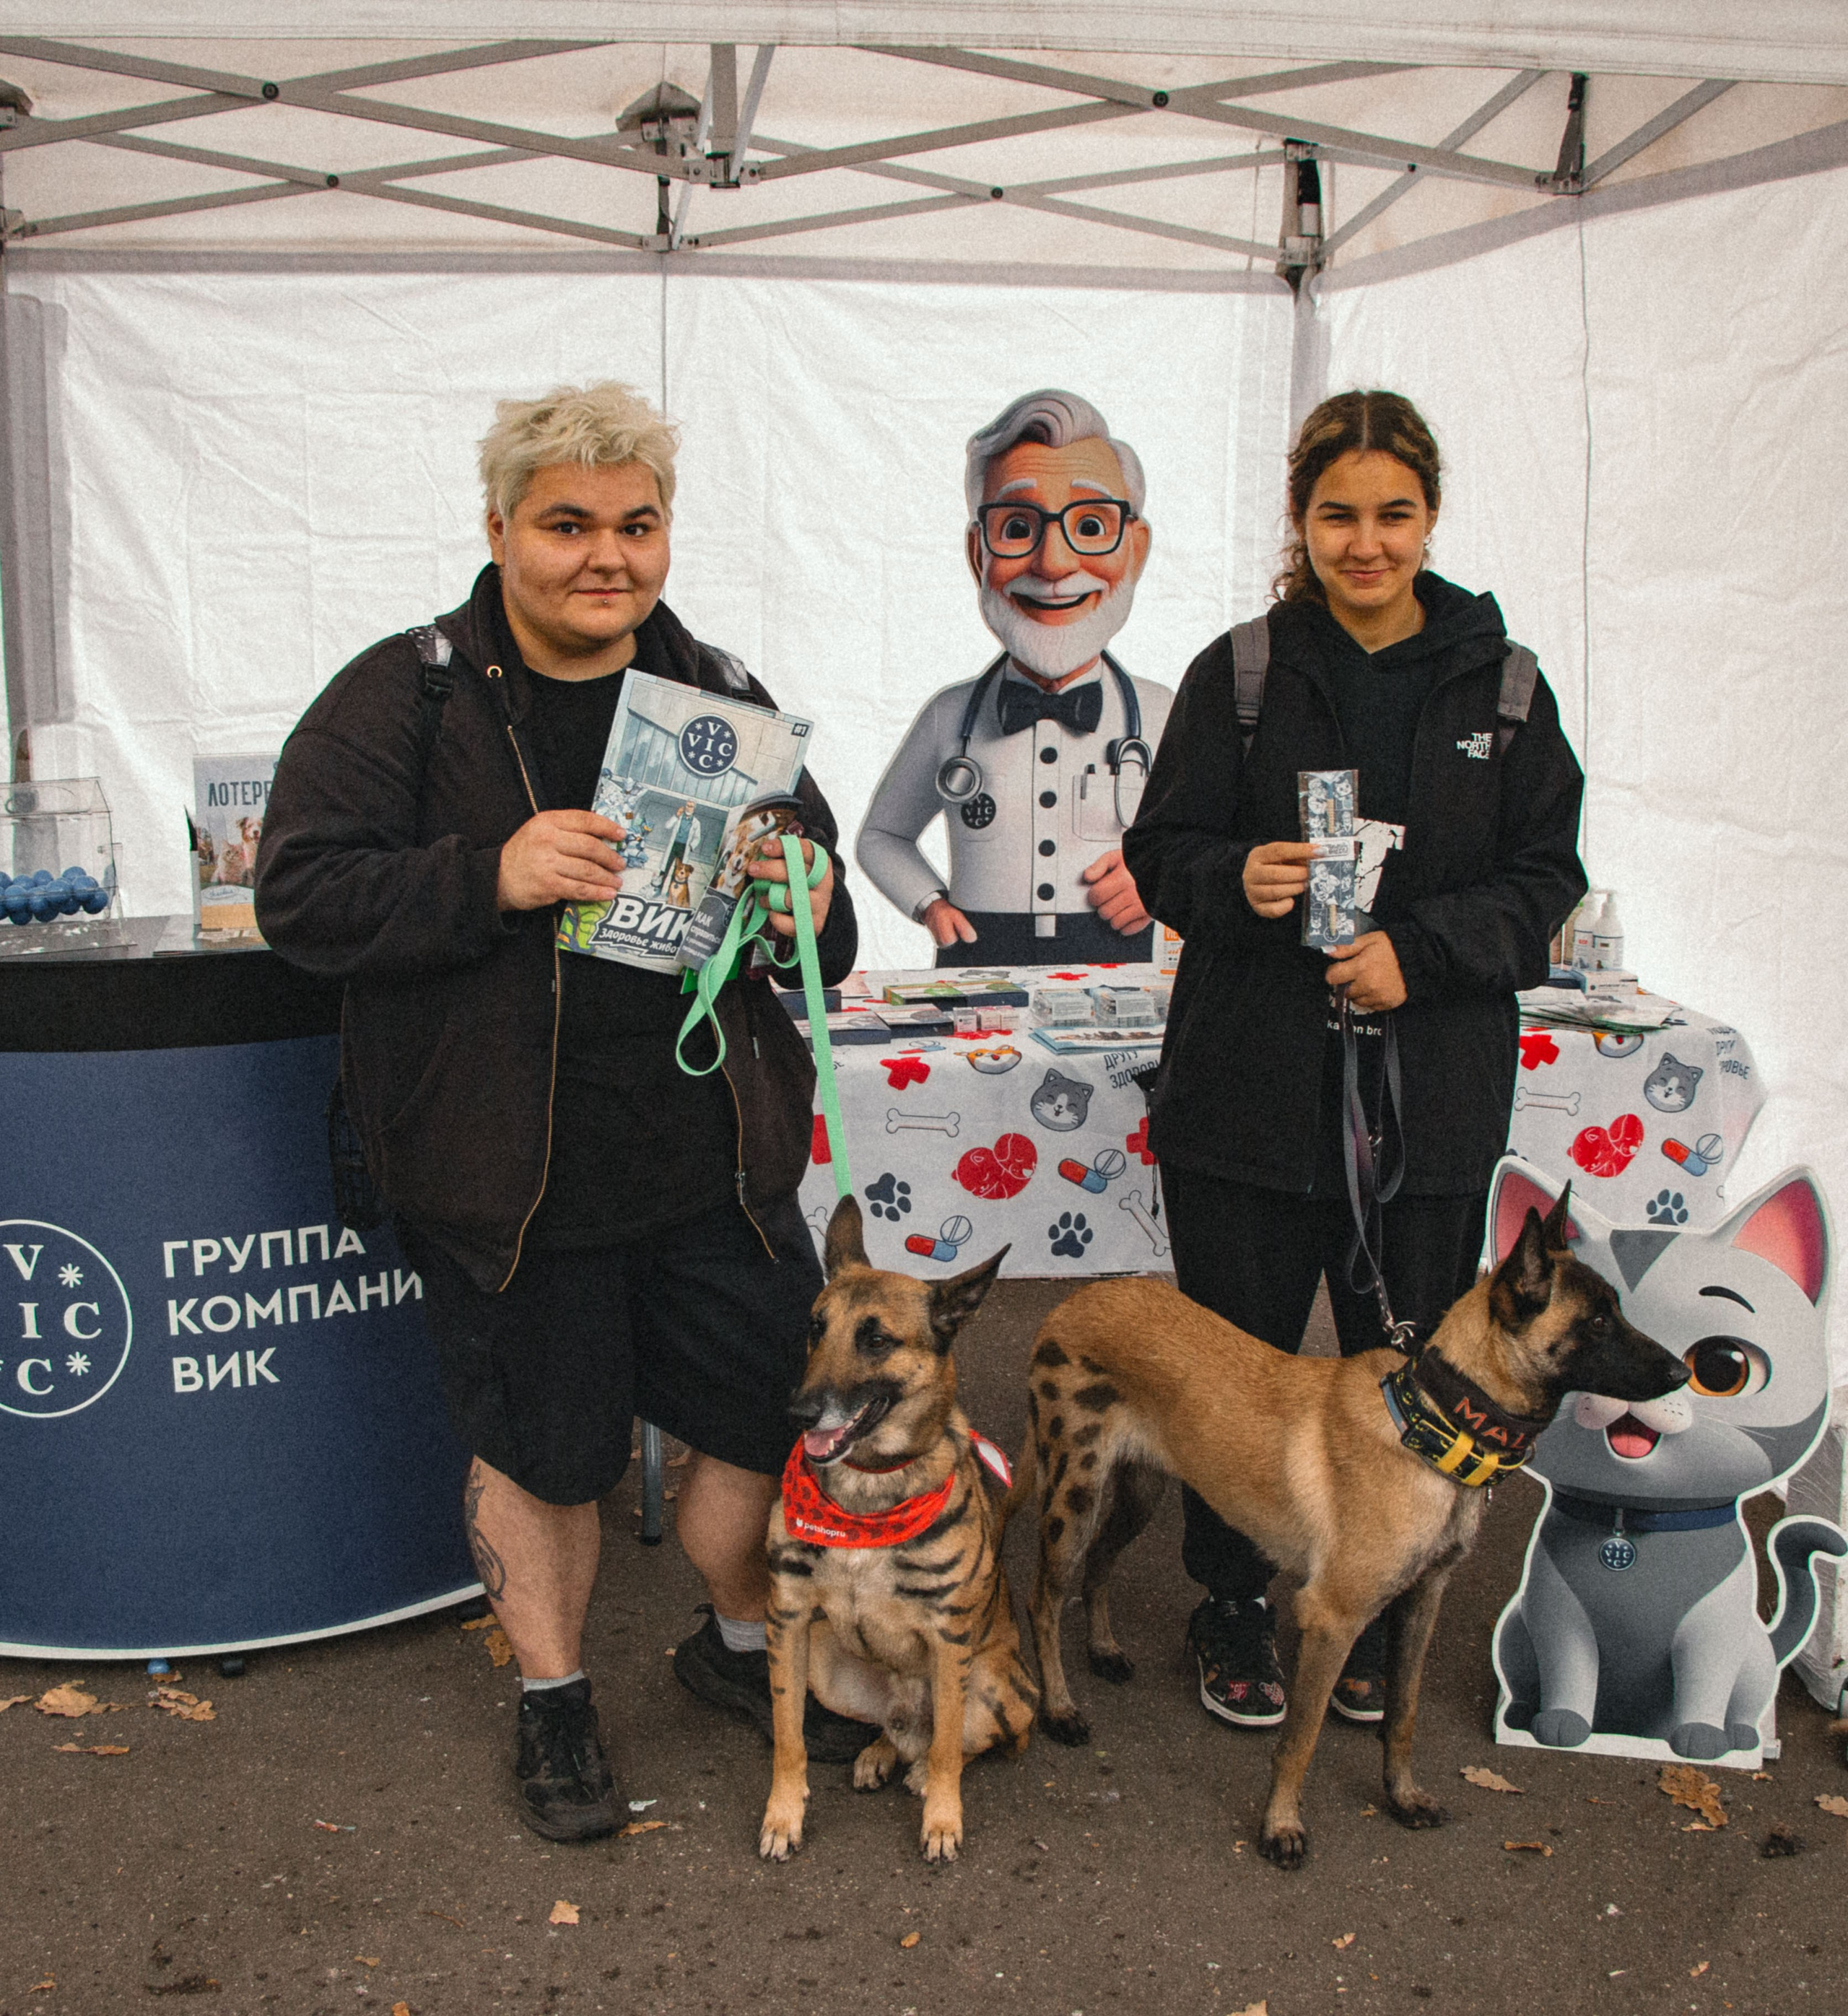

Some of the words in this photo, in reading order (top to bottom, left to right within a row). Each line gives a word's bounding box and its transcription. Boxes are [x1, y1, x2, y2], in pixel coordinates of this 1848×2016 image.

[1456, 740, 1492, 750] NORTH
[1471, 733, 1494, 742] THE
[208, 780, 273, 807] ЛОТЕРЕ
[606, 897, 694, 941] ВИК
[694, 911, 713, 927] КАК
[4, 1244, 44, 1280] V
[163, 1224, 367, 1278] ГРУППА
[167, 1268, 423, 1336] КОМПАНИ
[18, 1302, 103, 1340] IC
[17, 1358, 54, 1395] C
[172, 1347, 280, 1393] ВИК
[804, 1522, 846, 1537] petshopru
[1604, 1550, 1631, 1559] VIC
